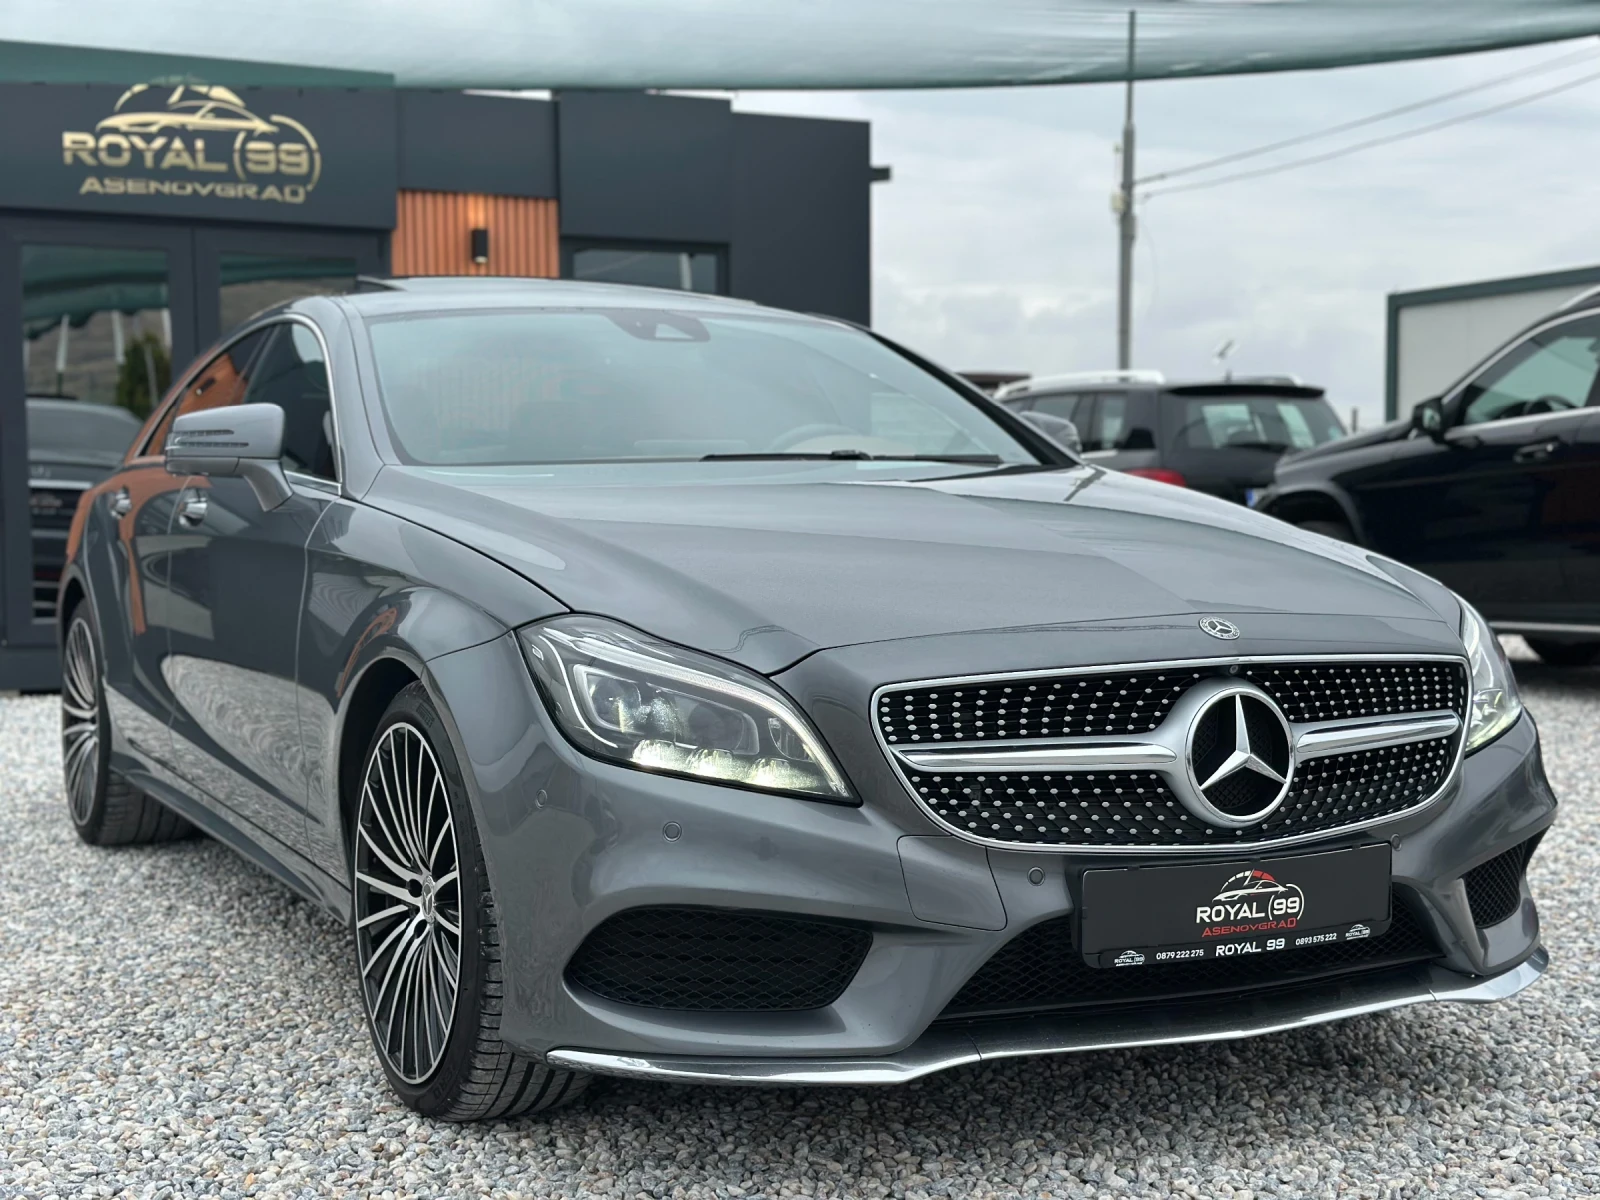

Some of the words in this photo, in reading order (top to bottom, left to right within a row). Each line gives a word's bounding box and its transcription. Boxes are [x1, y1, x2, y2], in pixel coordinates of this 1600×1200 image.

[62, 131, 229, 172] ROYAL
[79, 176, 306, 204] ASENOVGRAD
[1196, 902, 1266, 924] ROYAL
[1202, 917, 1297, 938] ASENOVGRAD
[1215, 941, 1261, 957] ROYAL
[1266, 938, 1286, 951] 99
[1295, 936, 1313, 946] 0893
[1313, 934, 1325, 943] 575
[1325, 932, 1337, 942] 222
[1156, 951, 1175, 960] 0879
[1175, 950, 1190, 959] 222
[1190, 949, 1204, 958] 275
